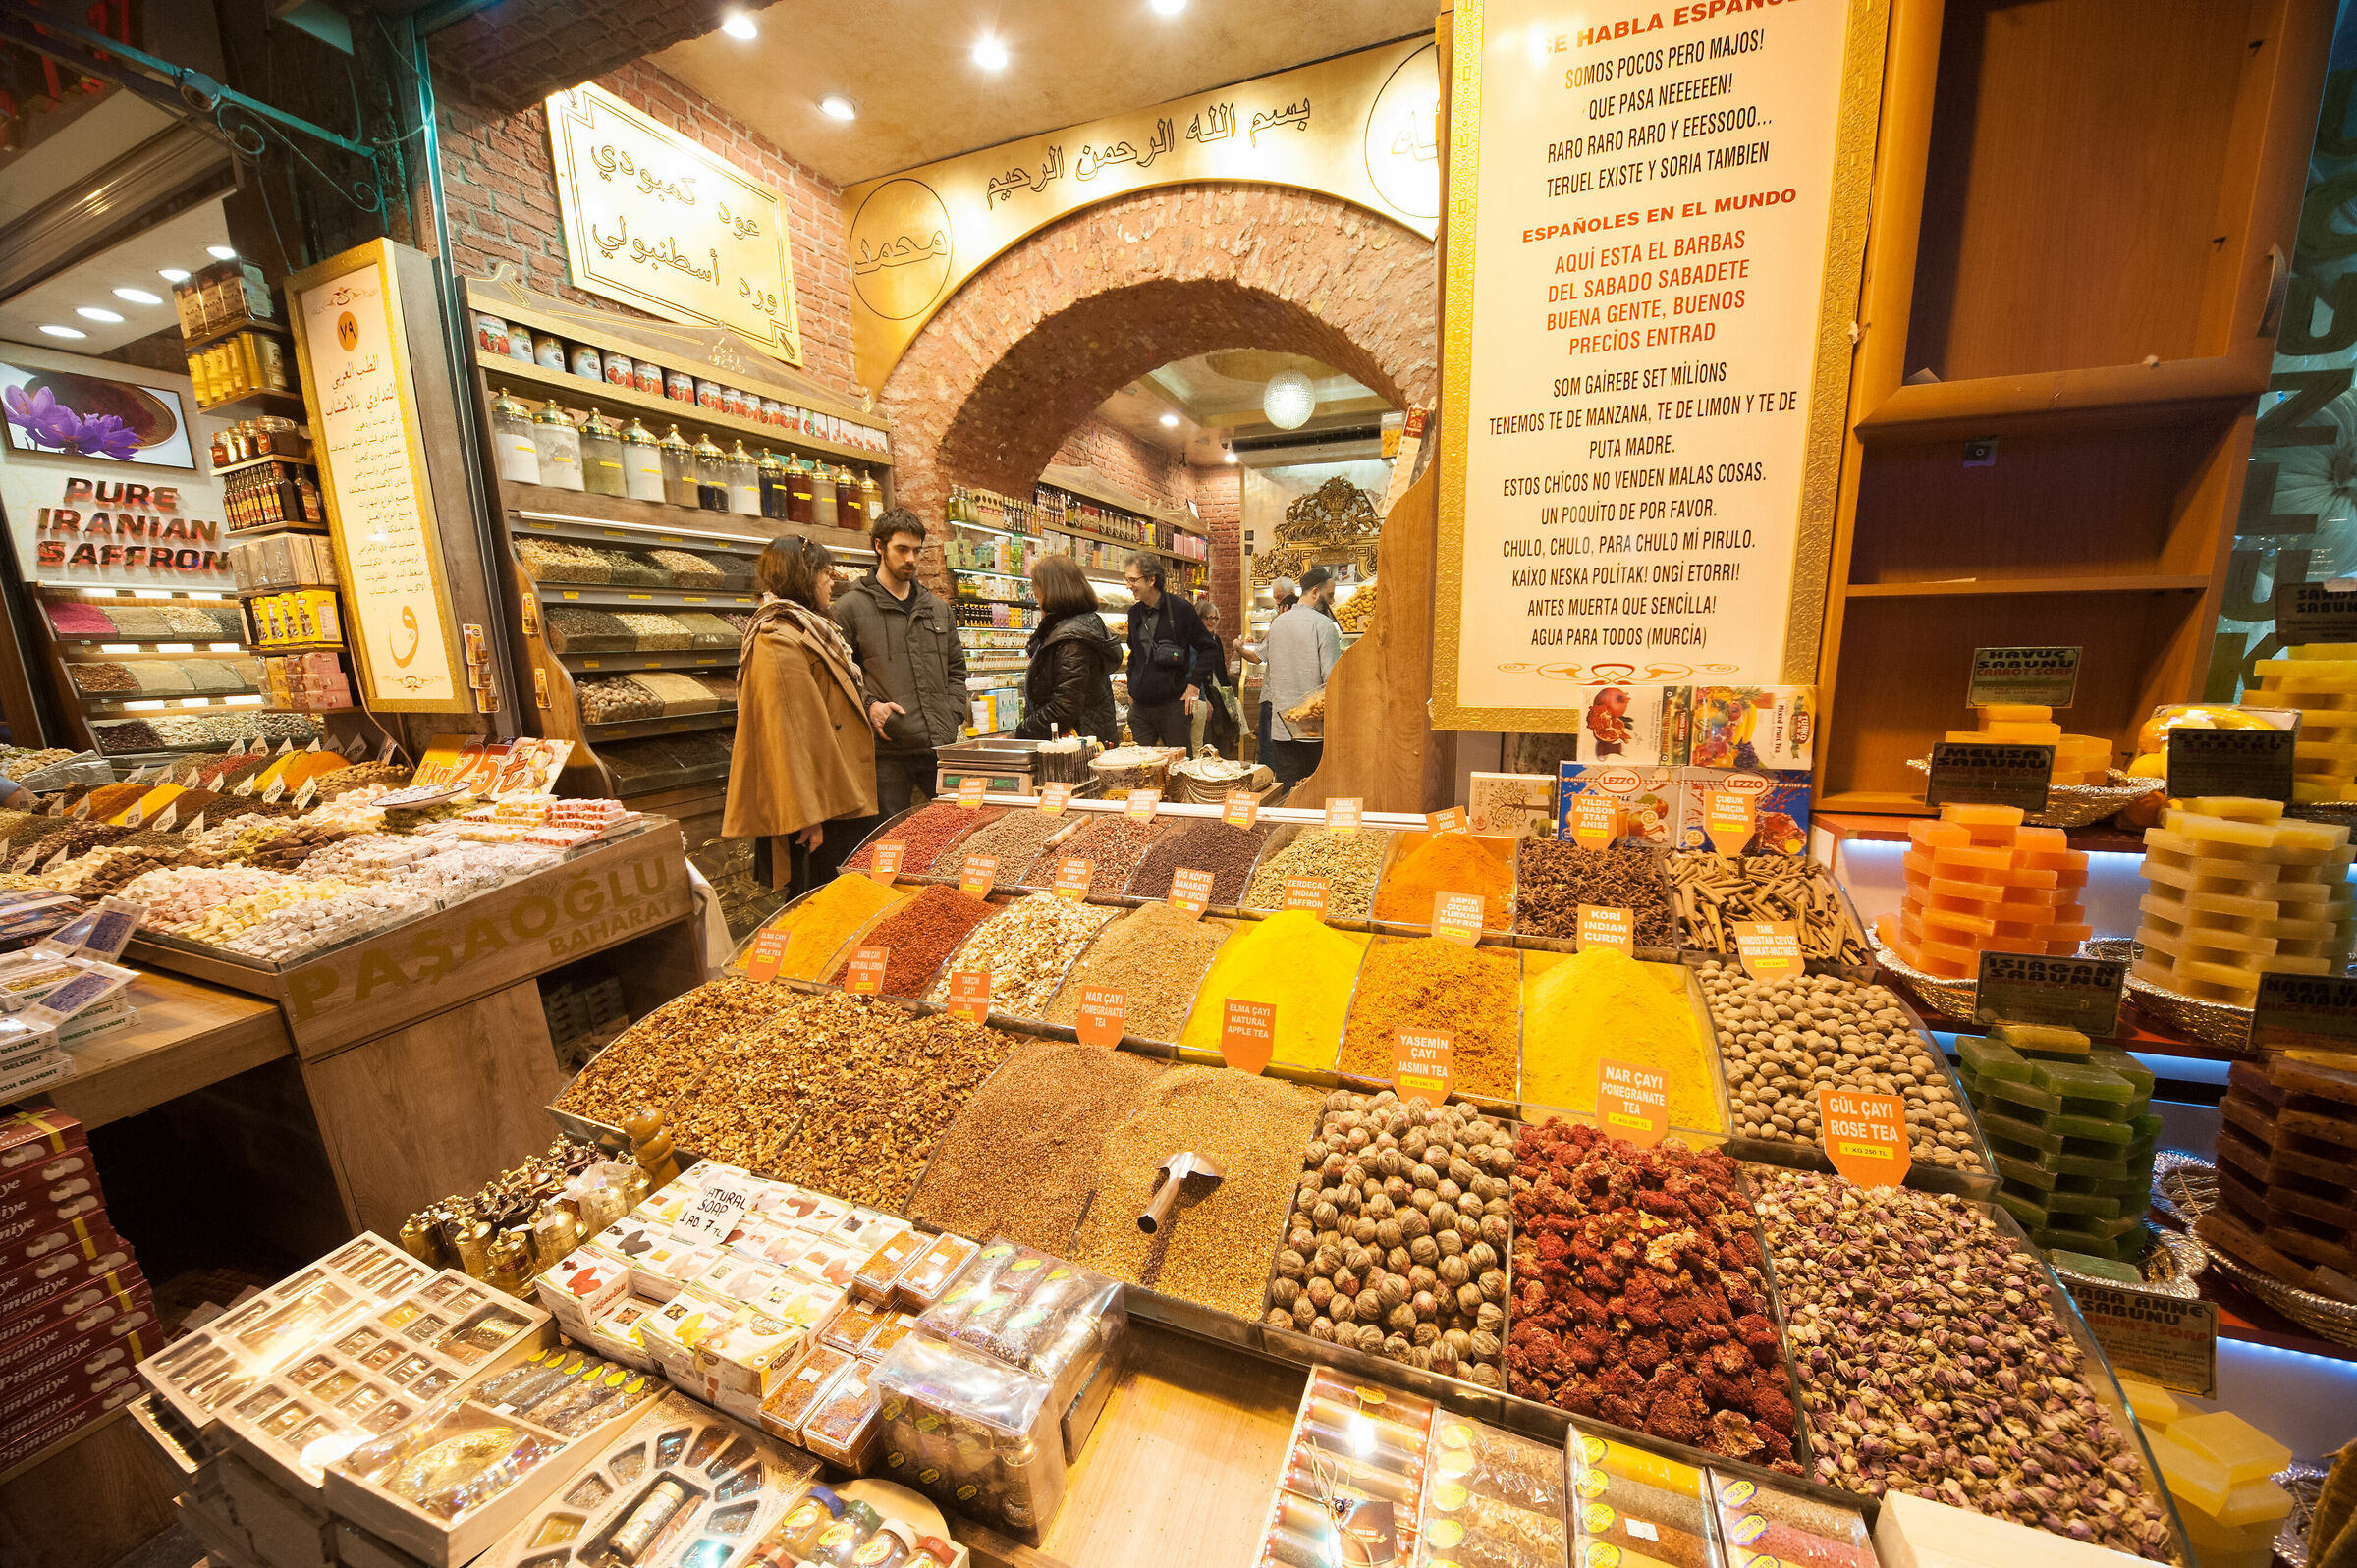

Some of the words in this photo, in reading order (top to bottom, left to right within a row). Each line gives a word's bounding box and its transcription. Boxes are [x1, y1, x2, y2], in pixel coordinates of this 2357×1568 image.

[1577, 13, 1664, 47] HABLA
[1566, 59, 1614, 88] SOMOS
[1617, 48, 1664, 79] POCOS
[1668, 40, 1705, 69] PERO
[1709, 27, 1765, 60] MAJOS!
[1588, 95, 1616, 121] QUE
[1618, 87, 1654, 115] PASA
[1185, 102, 1236, 143] الله
[1248, 97, 1311, 149] بسم
[1076, 118, 1175, 181] الرحمن
[591, 144, 696, 206] كمبودي
[986, 146, 1065, 211] الرحيم
[1547, 171, 1594, 198] TERUEL
[1598, 161, 1644, 189] EXISTE
[1648, 159, 1657, 181] Y
[1660, 151, 1702, 179] SORIA
[1706, 140, 1770, 171] TAMBIEN
[718, 202, 760, 240] عود
[1522, 211, 1640, 243] ESPAÑOLES
[1646, 205, 1674, 223] EN
[1681, 201, 1707, 218] EL
[1714, 188, 1796, 213] MUNDO
[853, 225, 948, 275] محمد
[1600, 243, 1642, 268] ESTA
[1647, 241, 1668, 261] EL
[1673, 229, 1745, 257] BARBAS
[1548, 282, 1578, 303] DEL
[1583, 271, 1652, 298] SABADO
[1658, 258, 1750, 289] SABADETE
[739, 278, 778, 315] ورد
[1547, 306, 1601, 331] BUENA
[1606, 298, 1666, 323] GENTE,
[1672, 289, 1745, 315] BUENOS
[1646, 322, 1716, 347] ENTRAD
[1553, 376, 1581, 398] SOM
[1642, 367, 1668, 389] SET
[1589, 438, 1621, 459] PUTA
[1625, 434, 1675, 457] MADRE.
[1503, 476, 1540, 497] ESTOS
[1592, 471, 1611, 491] NO
[1614, 467, 1665, 489] VENDEN
[1668, 464, 1714, 486] MALAS
[1717, 461, 1766, 483] COSAS.
[65, 477, 178, 511] PURE
[38, 508, 218, 543] IRANIAN
[1503, 538, 1546, 558] CHULO,
[1550, 536, 1595, 558] CHULO,
[1599, 534, 1631, 554] PARA
[1635, 531, 1678, 552] CHULO
[1702, 528, 1755, 550] PIRULO.
[37, 540, 229, 571] SAFFRON
[1550, 568, 1588, 586] NESKA
[1687, 562, 1740, 582] ETORRI!
[1527, 598, 1564, 617] ANTES
[1567, 597, 1618, 616] MUERTA
[1621, 596, 1648, 616] QUE
[1530, 628, 1562, 646] AGUA
[1565, 627, 1598, 645] PARA
[1602, 627, 1643, 646] TODOS
[1978, 660, 2074, 669] SABUNU
[1937, 758, 2046, 769] SABUNU
[1602, 775, 1635, 786] LEZZO
[1727, 780, 1765, 789] LEZZO
[1575, 806, 1616, 815] ANASON
[1579, 798, 1612, 808] YILDIZ
[1580, 821, 1609, 830] ANISE
[1582, 813, 1608, 822] STAR
[1711, 812, 1749, 823] CINNAMON
[1287, 879, 1327, 892] ZERDEÇAL
[1292, 889, 1320, 899] INDIAN
[1288, 897, 1324, 908] SAFFRON
[549, 900, 674, 958] BAHARAT
[1584, 921, 1627, 933] INDIAN
[1584, 932, 1627, 945] CURRY
[288, 856, 668, 1023] PAŞAOĞLU
[1990, 968, 2112, 987] SABUNU
[1085, 991, 1102, 1002] NAR
[1104, 992, 1123, 1006] ÇAYI
[1229, 1003, 1250, 1014] ELMA
[1251, 1006, 1271, 1018] ÇAYI
[1081, 1004, 1123, 1018] POMEGRANATE
[1095, 1017, 1106, 1028] TEA
[1231, 1014, 1267, 1027] NATURAL
[92, 1017, 127, 1033] DELIGHT
[1227, 1025, 1251, 1036] APPLE
[1253, 1029, 1269, 1038] TEA
[1410, 1048, 1436, 1060] ÇAYI
[1397, 1061, 1429, 1075] JASMIN
[1431, 1064, 1448, 1078] TEA
[1605, 1066, 1631, 1082] NAR
[1633, 1071, 1663, 1090] ÇAYI
[1601, 1082, 1666, 1107] POMEGRANATE
[1623, 1101, 1641, 1116] TEA
[1830, 1096, 1858, 1115] GÜL
[1861, 1101, 1893, 1120] ÇAYI
[1831, 1119, 1868, 1139] ROSE
[1870, 1124, 1900, 1142] TEA
[697, 1198, 729, 1217] SOAP
[704, 1186, 746, 1210] ATURAL
[704, 1219, 715, 1232] 7
[2081, 1300, 2180, 1325] SABUNU
